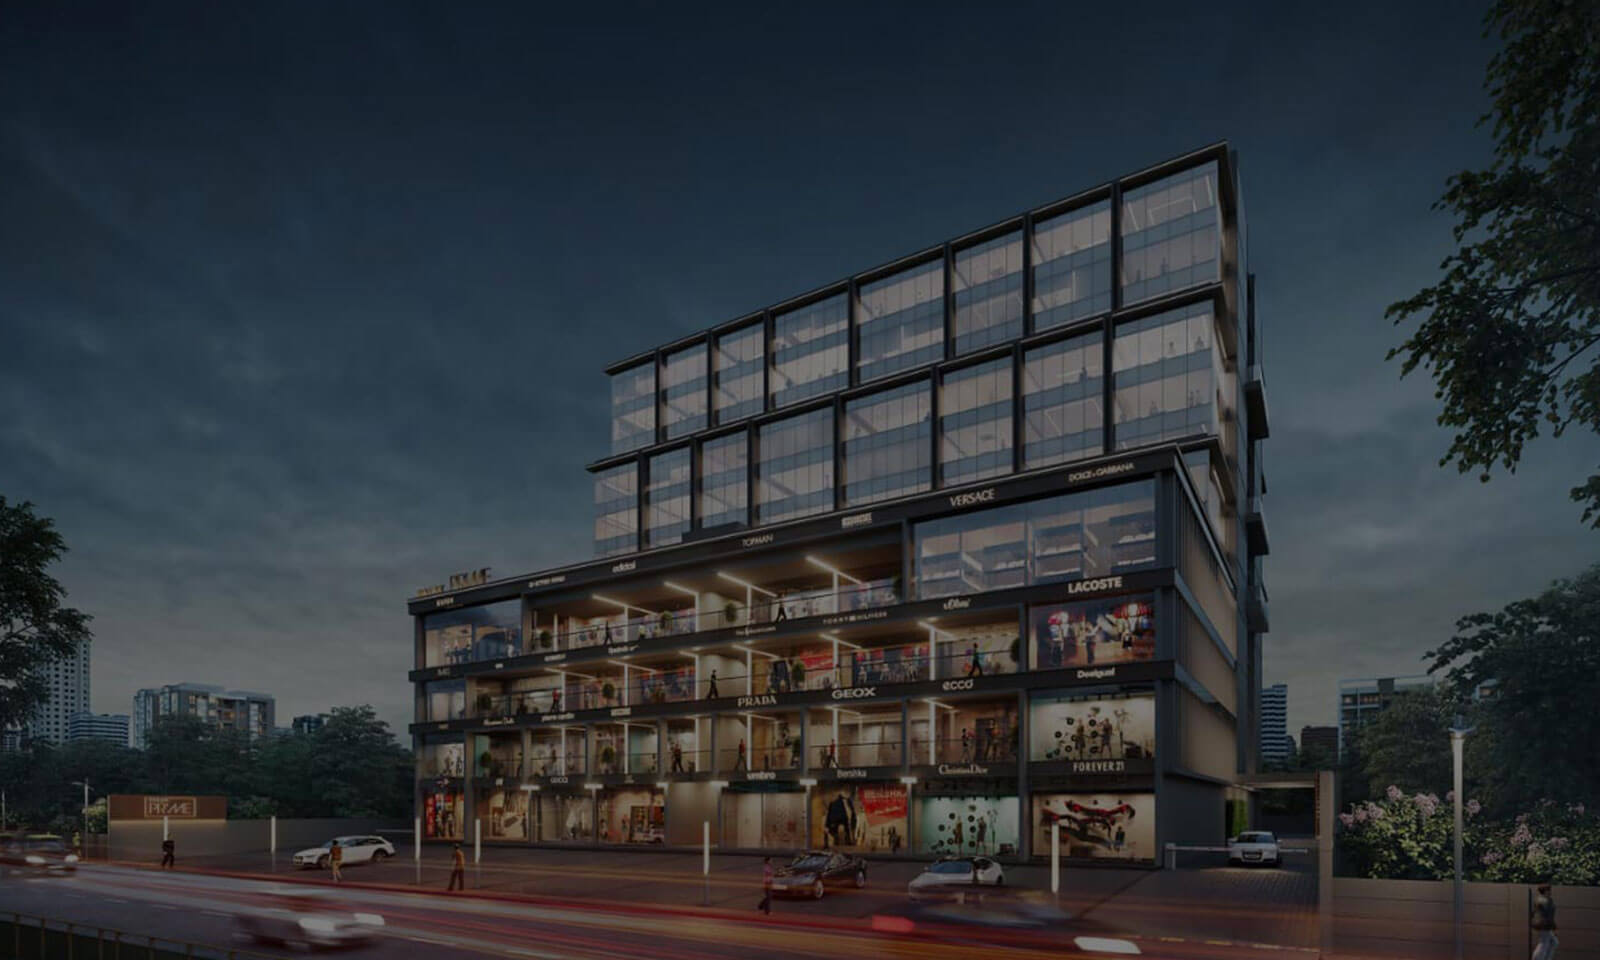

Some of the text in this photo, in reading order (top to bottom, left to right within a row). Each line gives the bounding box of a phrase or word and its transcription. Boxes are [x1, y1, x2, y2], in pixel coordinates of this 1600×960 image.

[949, 488, 995, 506] VERSACE
[1068, 576, 1123, 593] LACOSTE
[831, 687, 876, 699] GEOX
[737, 695, 777, 707] PRADA
